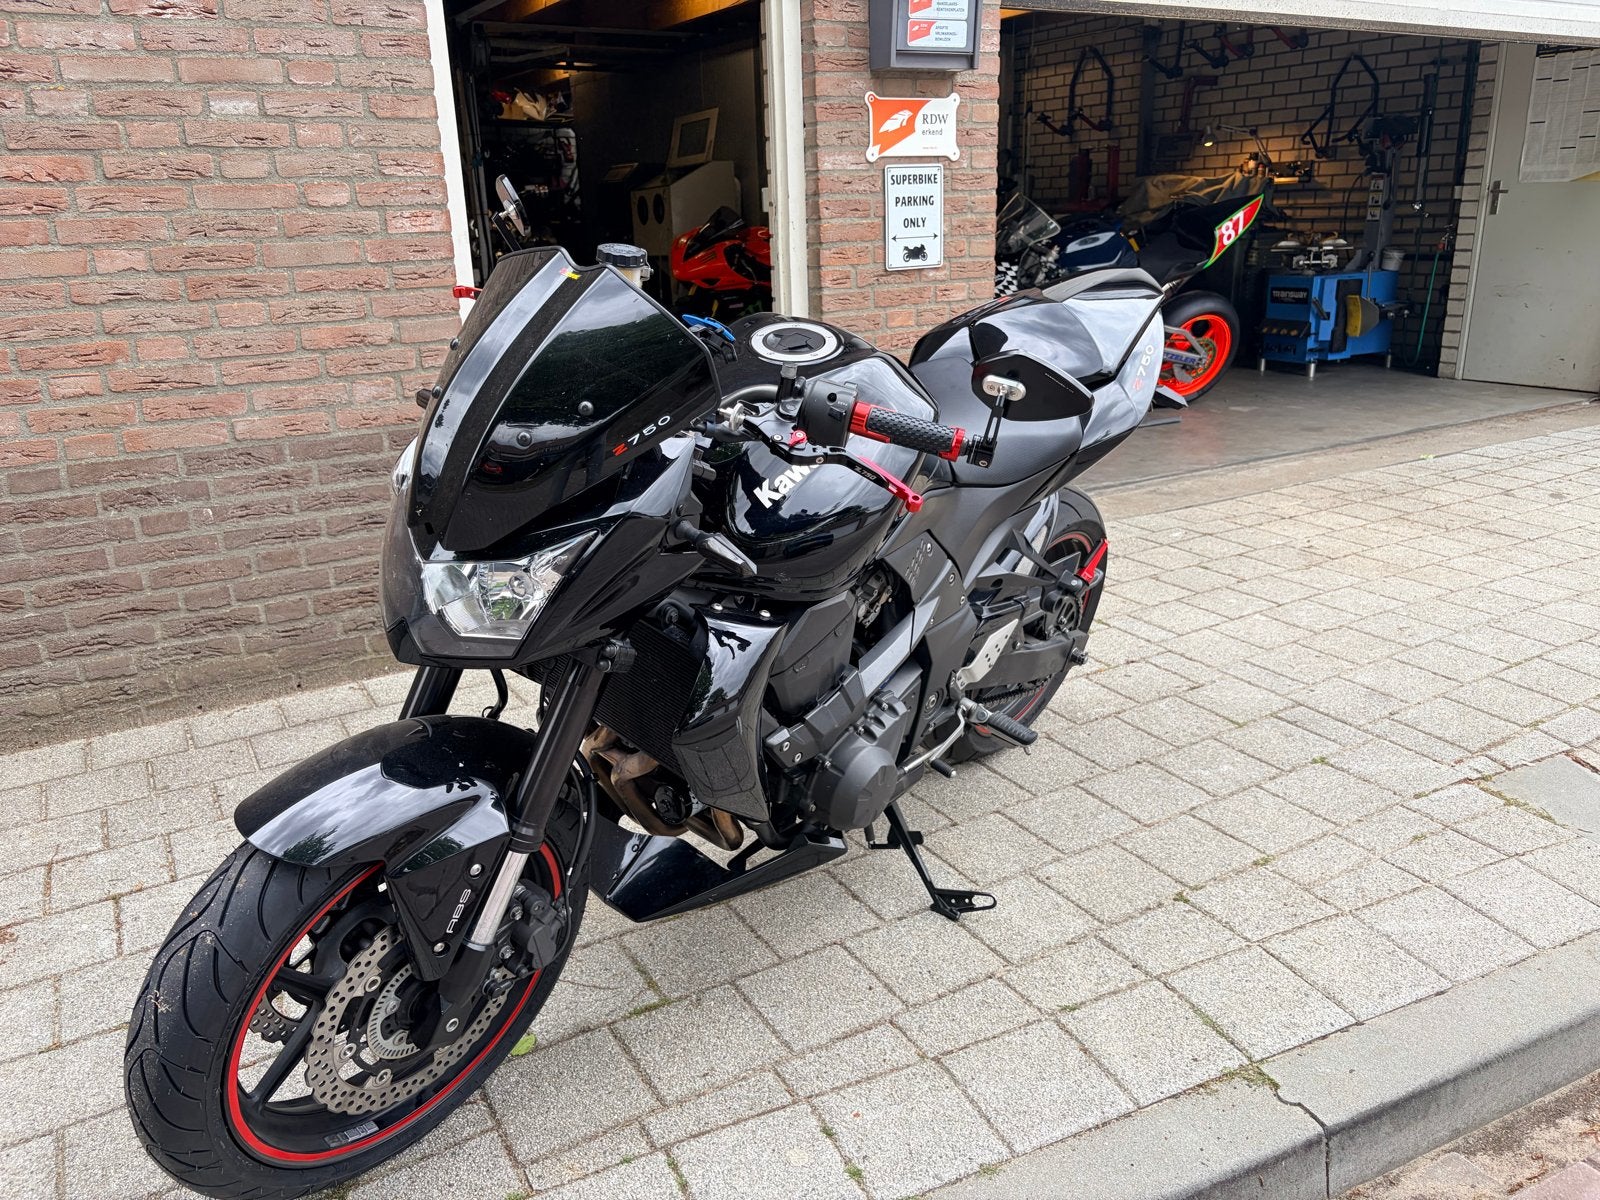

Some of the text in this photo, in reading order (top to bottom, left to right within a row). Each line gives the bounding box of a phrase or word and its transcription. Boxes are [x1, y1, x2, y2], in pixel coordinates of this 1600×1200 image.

[922, 113, 949, 125] RDW
[921, 127, 943, 136] erkend
[890, 173, 938, 186] SUPERBIKE
[895, 195, 935, 207] PARKING
[903, 217, 927, 229] ONLY
[1221, 210, 1245, 246] 87
[612, 415, 671, 457] Z750
[753, 464, 821, 509] Kaw
[446, 888, 472, 934] ABS
